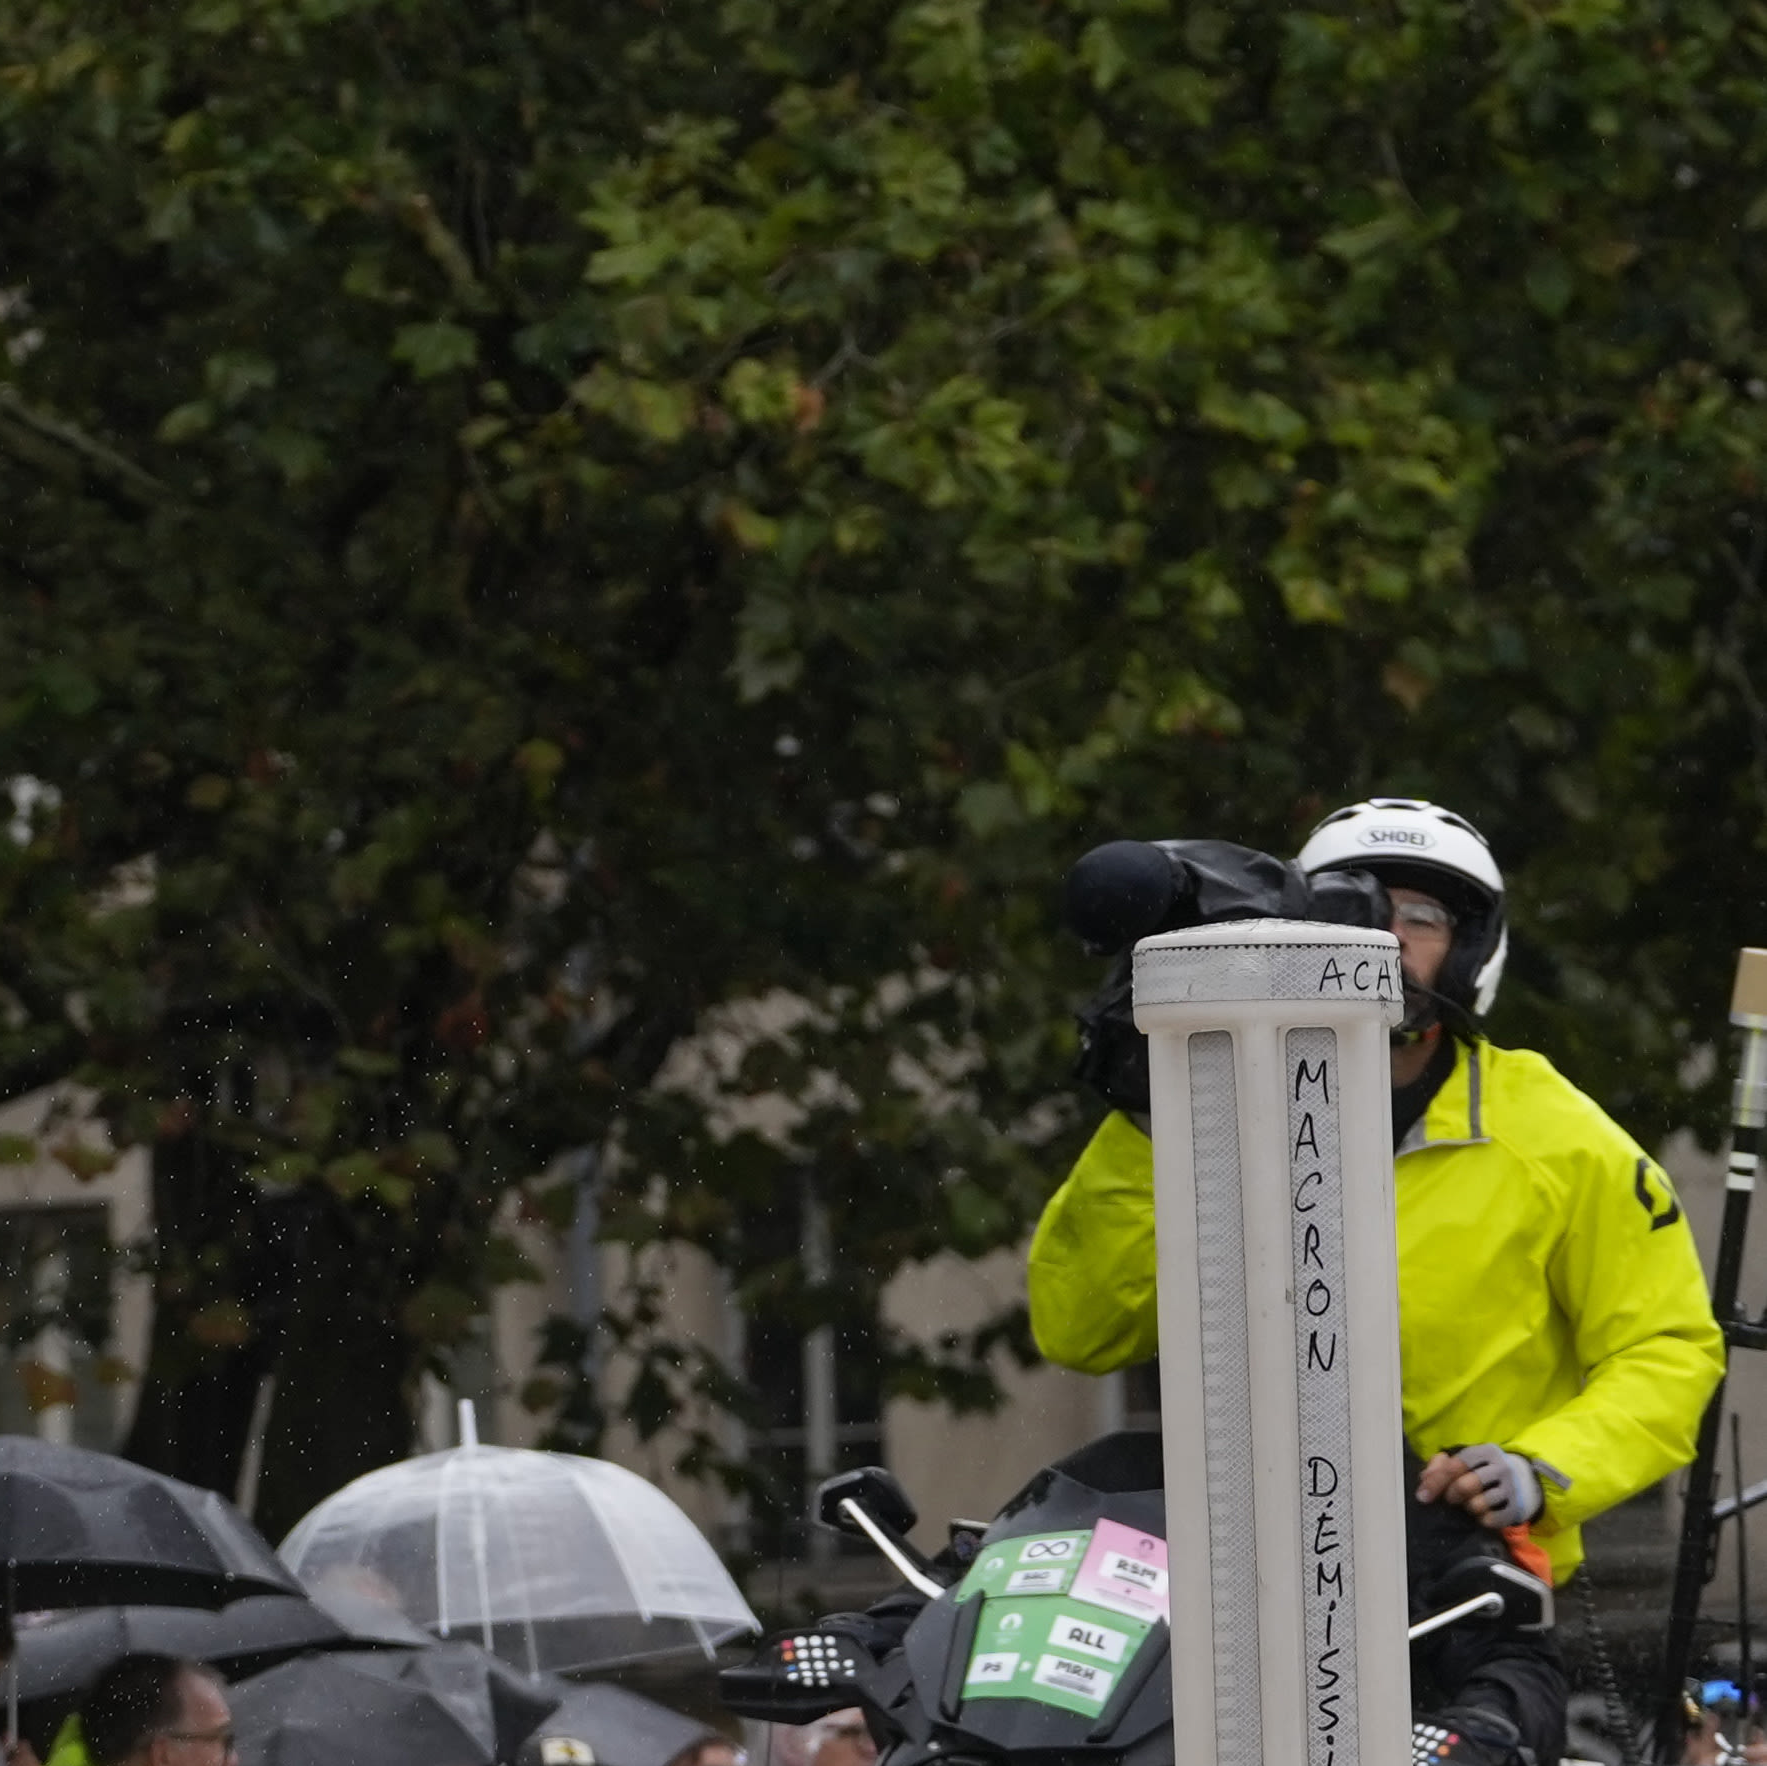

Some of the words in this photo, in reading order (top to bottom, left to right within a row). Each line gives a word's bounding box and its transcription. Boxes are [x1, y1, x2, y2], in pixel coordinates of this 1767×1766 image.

[1368, 829, 1425, 847] SHOEI
[1294, 1059, 1336, 1372] MACRON
[1068, 1627, 1105, 1650] ALL
